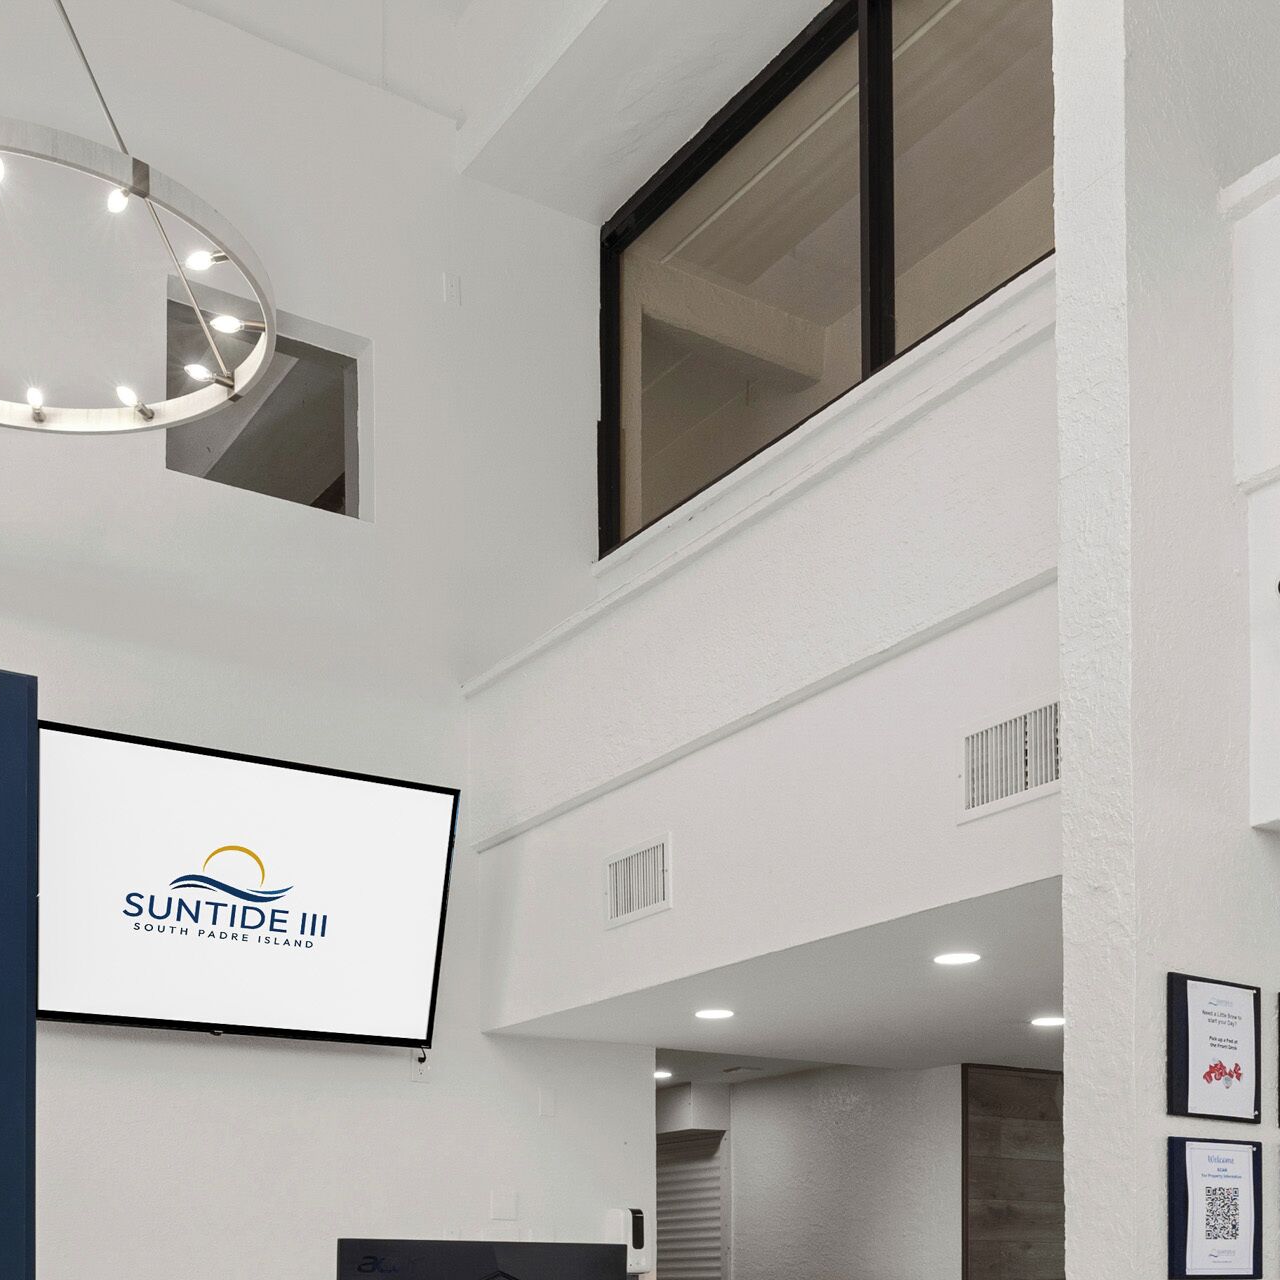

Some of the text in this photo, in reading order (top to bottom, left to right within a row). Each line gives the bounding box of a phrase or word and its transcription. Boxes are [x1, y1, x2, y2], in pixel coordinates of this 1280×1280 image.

[122, 892, 328, 938] SUNTIDE III
[133, 922, 314, 949] SOUTH PADRE ISLAND
